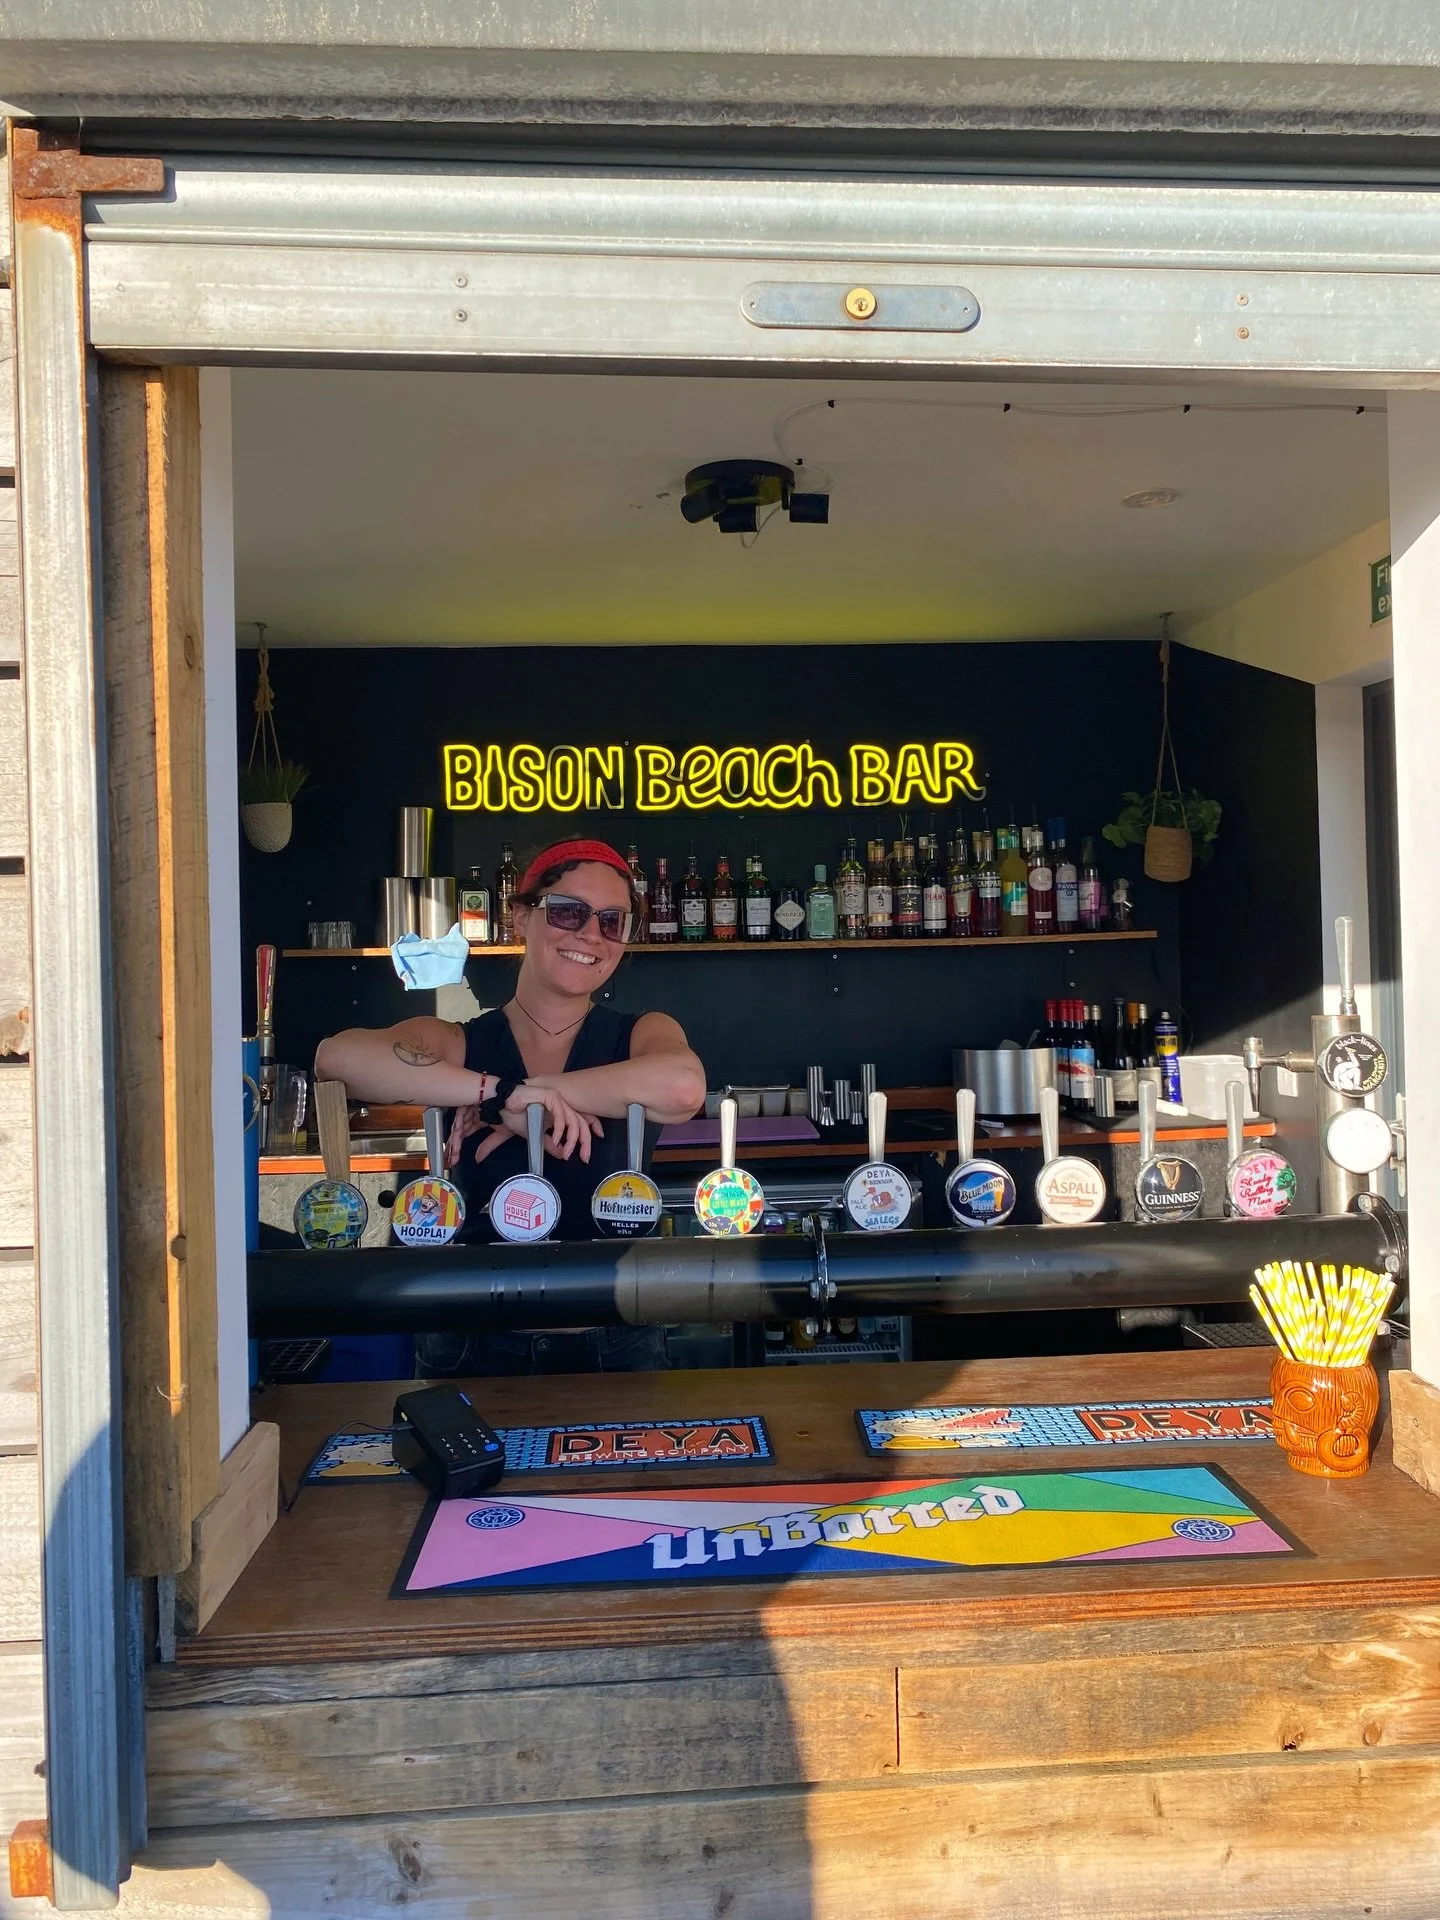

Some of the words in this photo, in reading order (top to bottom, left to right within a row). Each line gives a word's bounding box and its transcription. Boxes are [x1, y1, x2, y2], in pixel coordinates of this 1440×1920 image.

[444, 744, 624, 812] BISON
[850, 741, 988, 805] BAR
[1335, 1035, 1378, 1053] black-lines
[867, 1169, 891, 1179] DEYA
[982, 1179, 1004, 1194] MOON
[1046, 1178, 1099, 1197] ASPALL
[1145, 1190, 1201, 1206] GUINNESS
[506, 1205, 528, 1218] HOUSE
[401, 1226, 447, 1239] HOOPLA!
[611, 1221, 640, 1229] HELLES
[1089, 1408, 1274, 1431] DEYA
[559, 1427, 748, 1455] DEYA
[1103, 1428, 1193, 1439] BREWING
[557, 1449, 648, 1462] BREWING
[654, 1445, 749, 1457] COMPANY
[645, 1484, 1026, 1570] UnBarred
